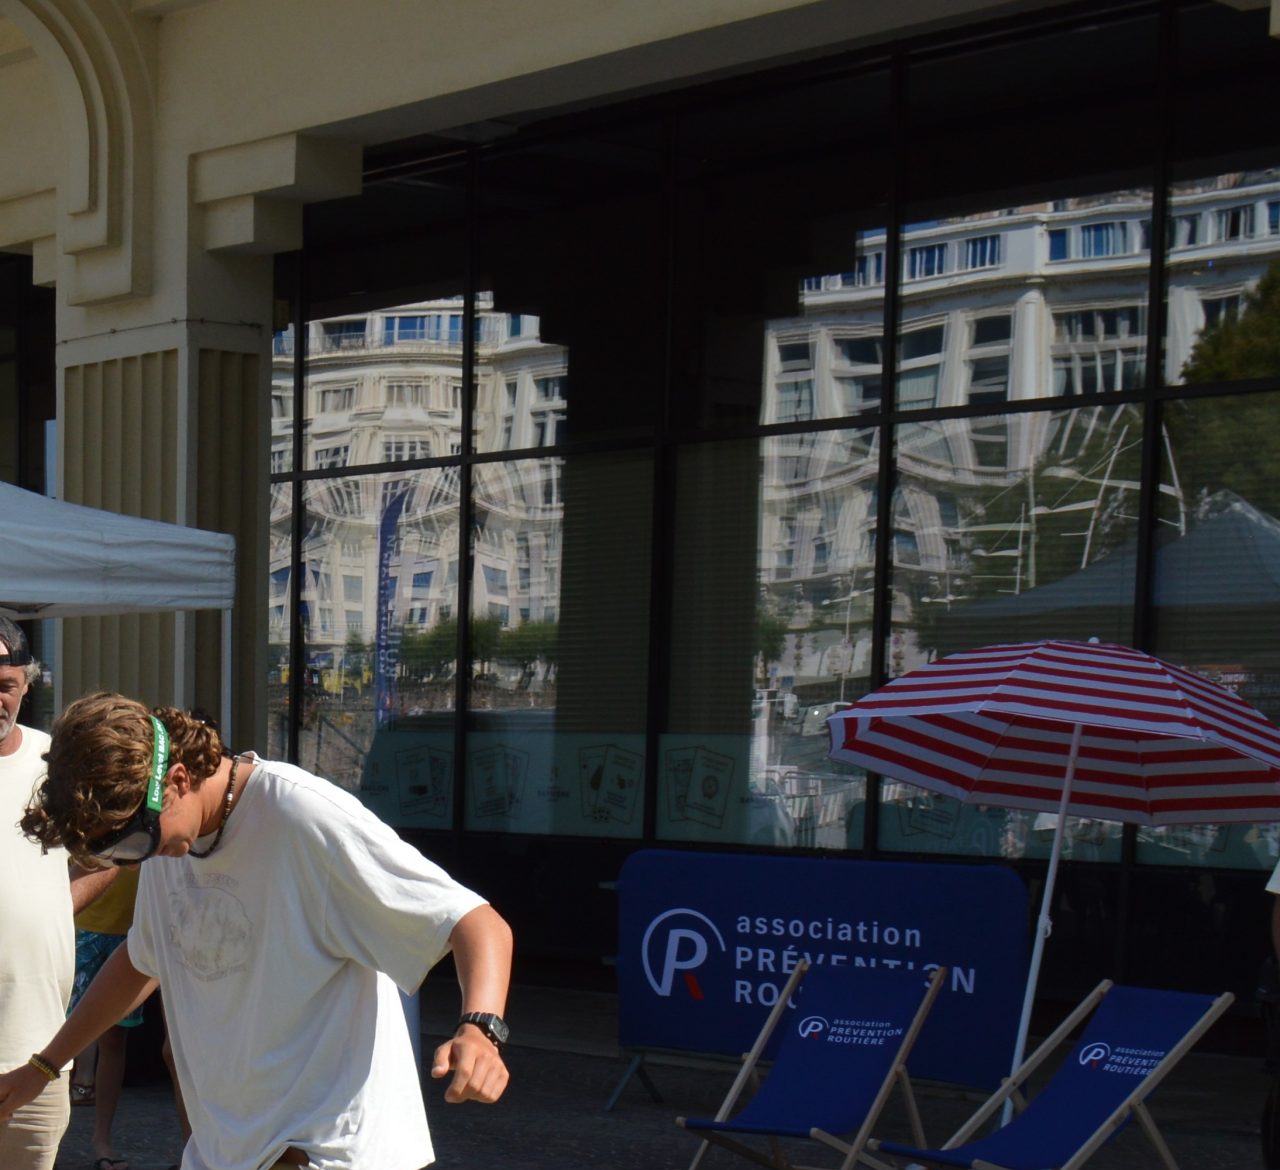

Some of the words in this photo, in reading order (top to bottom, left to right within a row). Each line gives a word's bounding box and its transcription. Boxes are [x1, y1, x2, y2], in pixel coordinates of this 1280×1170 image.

[736, 915, 921, 947] association
[830, 1027, 903, 1037] PRÉVENTION
[827, 1035, 885, 1045] ROUTIÈRE
[1108, 1054, 1161, 1066] PRÉVENTI
